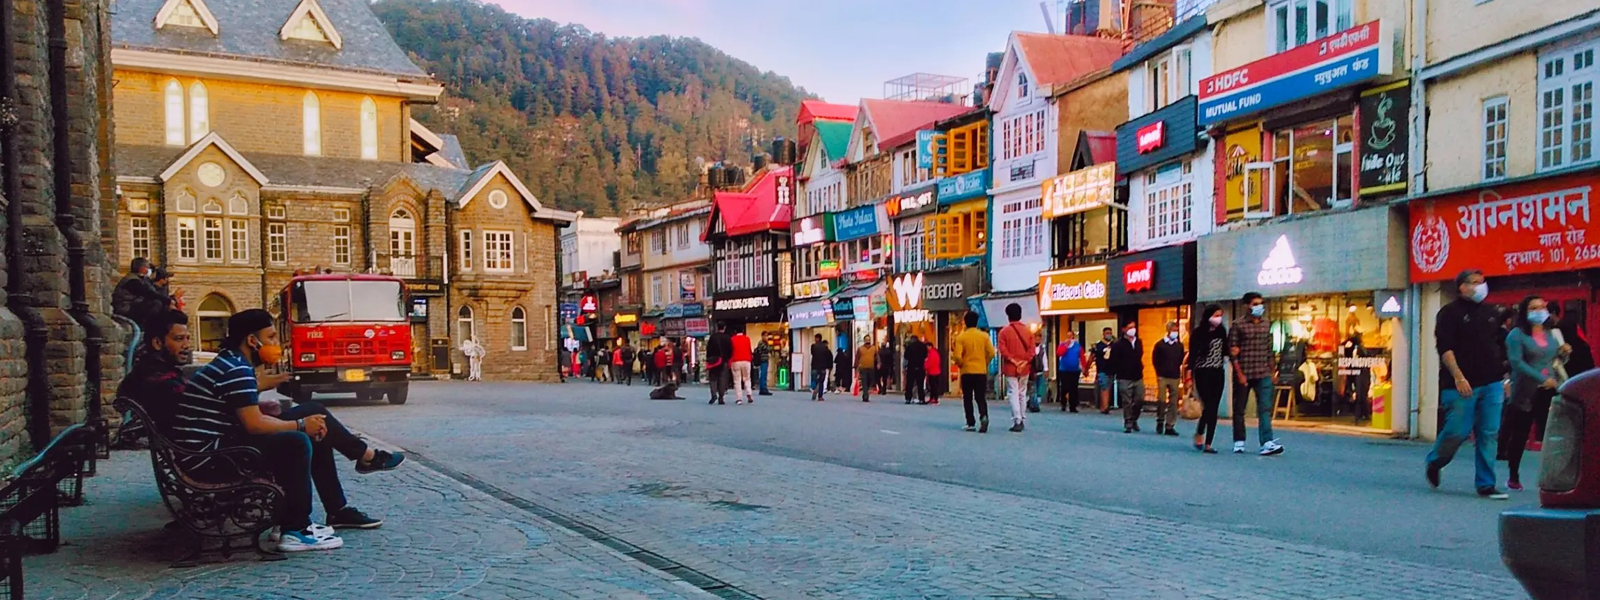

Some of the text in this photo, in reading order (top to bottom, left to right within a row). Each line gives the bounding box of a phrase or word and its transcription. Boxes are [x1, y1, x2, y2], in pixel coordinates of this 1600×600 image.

[1215, 69, 1249, 93] HDFC
[1205, 93, 1262, 119] MUTUAL FUND
[838, 209, 874, 229] Photo Palace
[1456, 185, 1592, 239] अग्निशमन
[1539, 225, 1587, 247] माल रोड
[1052, 279, 1106, 300] Hideout Cafe
[307, 330, 324, 339] FIRE
